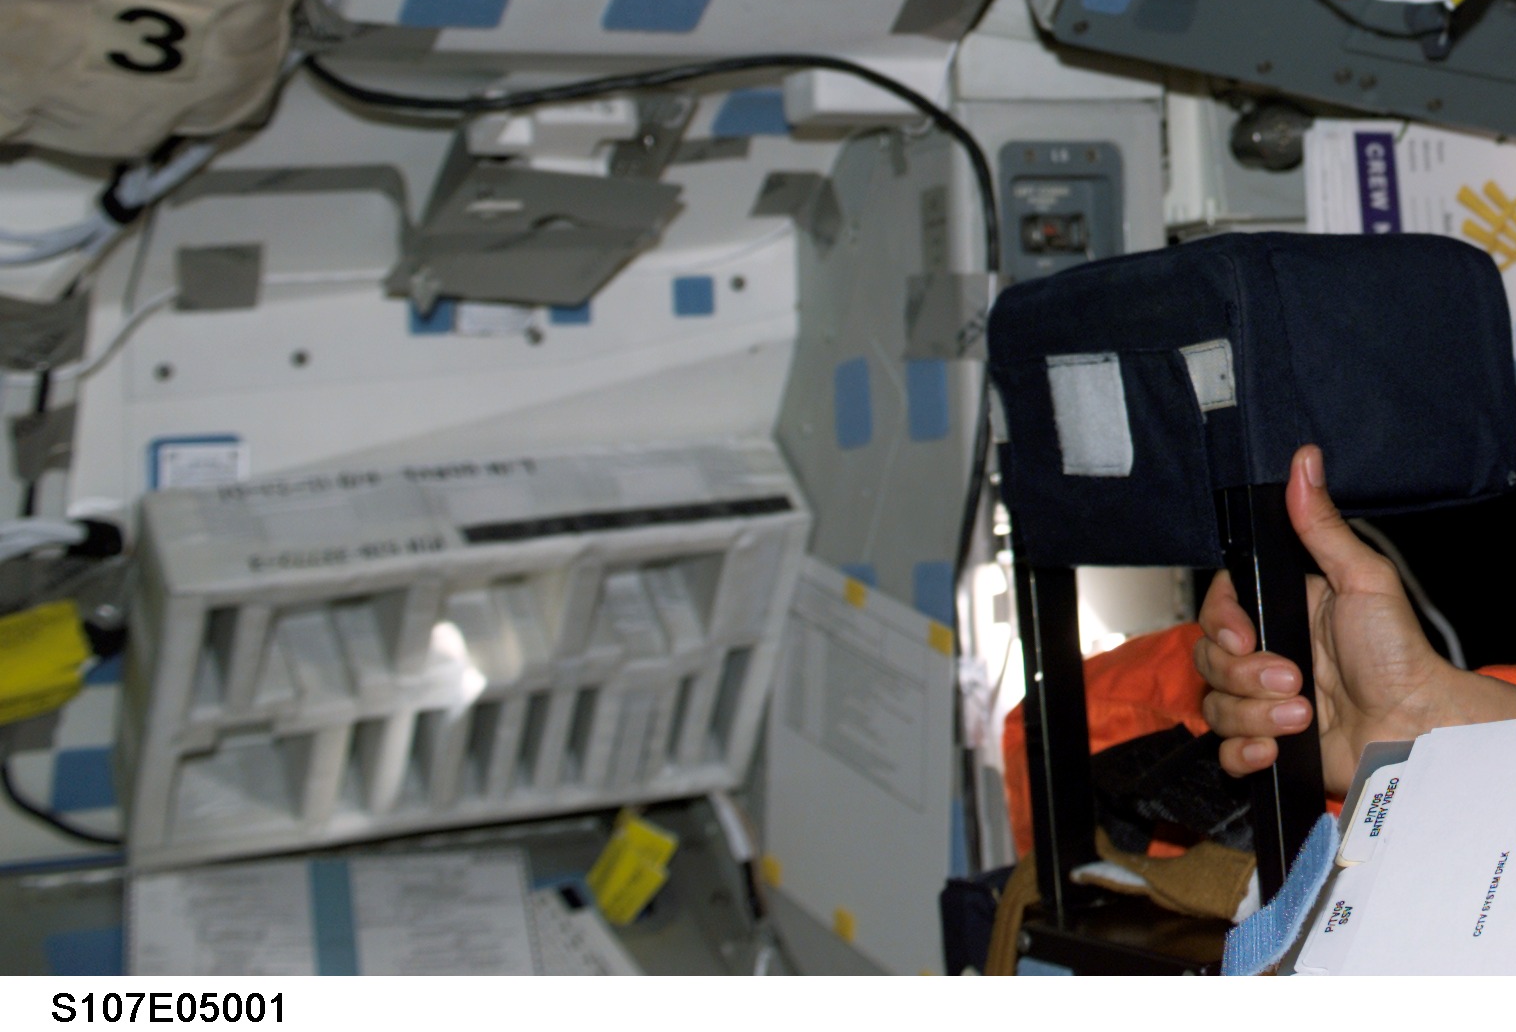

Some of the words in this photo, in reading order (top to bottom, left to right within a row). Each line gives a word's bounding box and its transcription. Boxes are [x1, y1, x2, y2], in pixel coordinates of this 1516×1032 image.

[107, 7, 187, 76] 3
[1364, 141, 1390, 212] CREW
[1369, 806, 1389, 838] ENTRY
[1381, 777, 1400, 806] VIDEO
[1473, 913, 1488, 938] CCTV
[1481, 875, 1502, 912] SYSTEM
